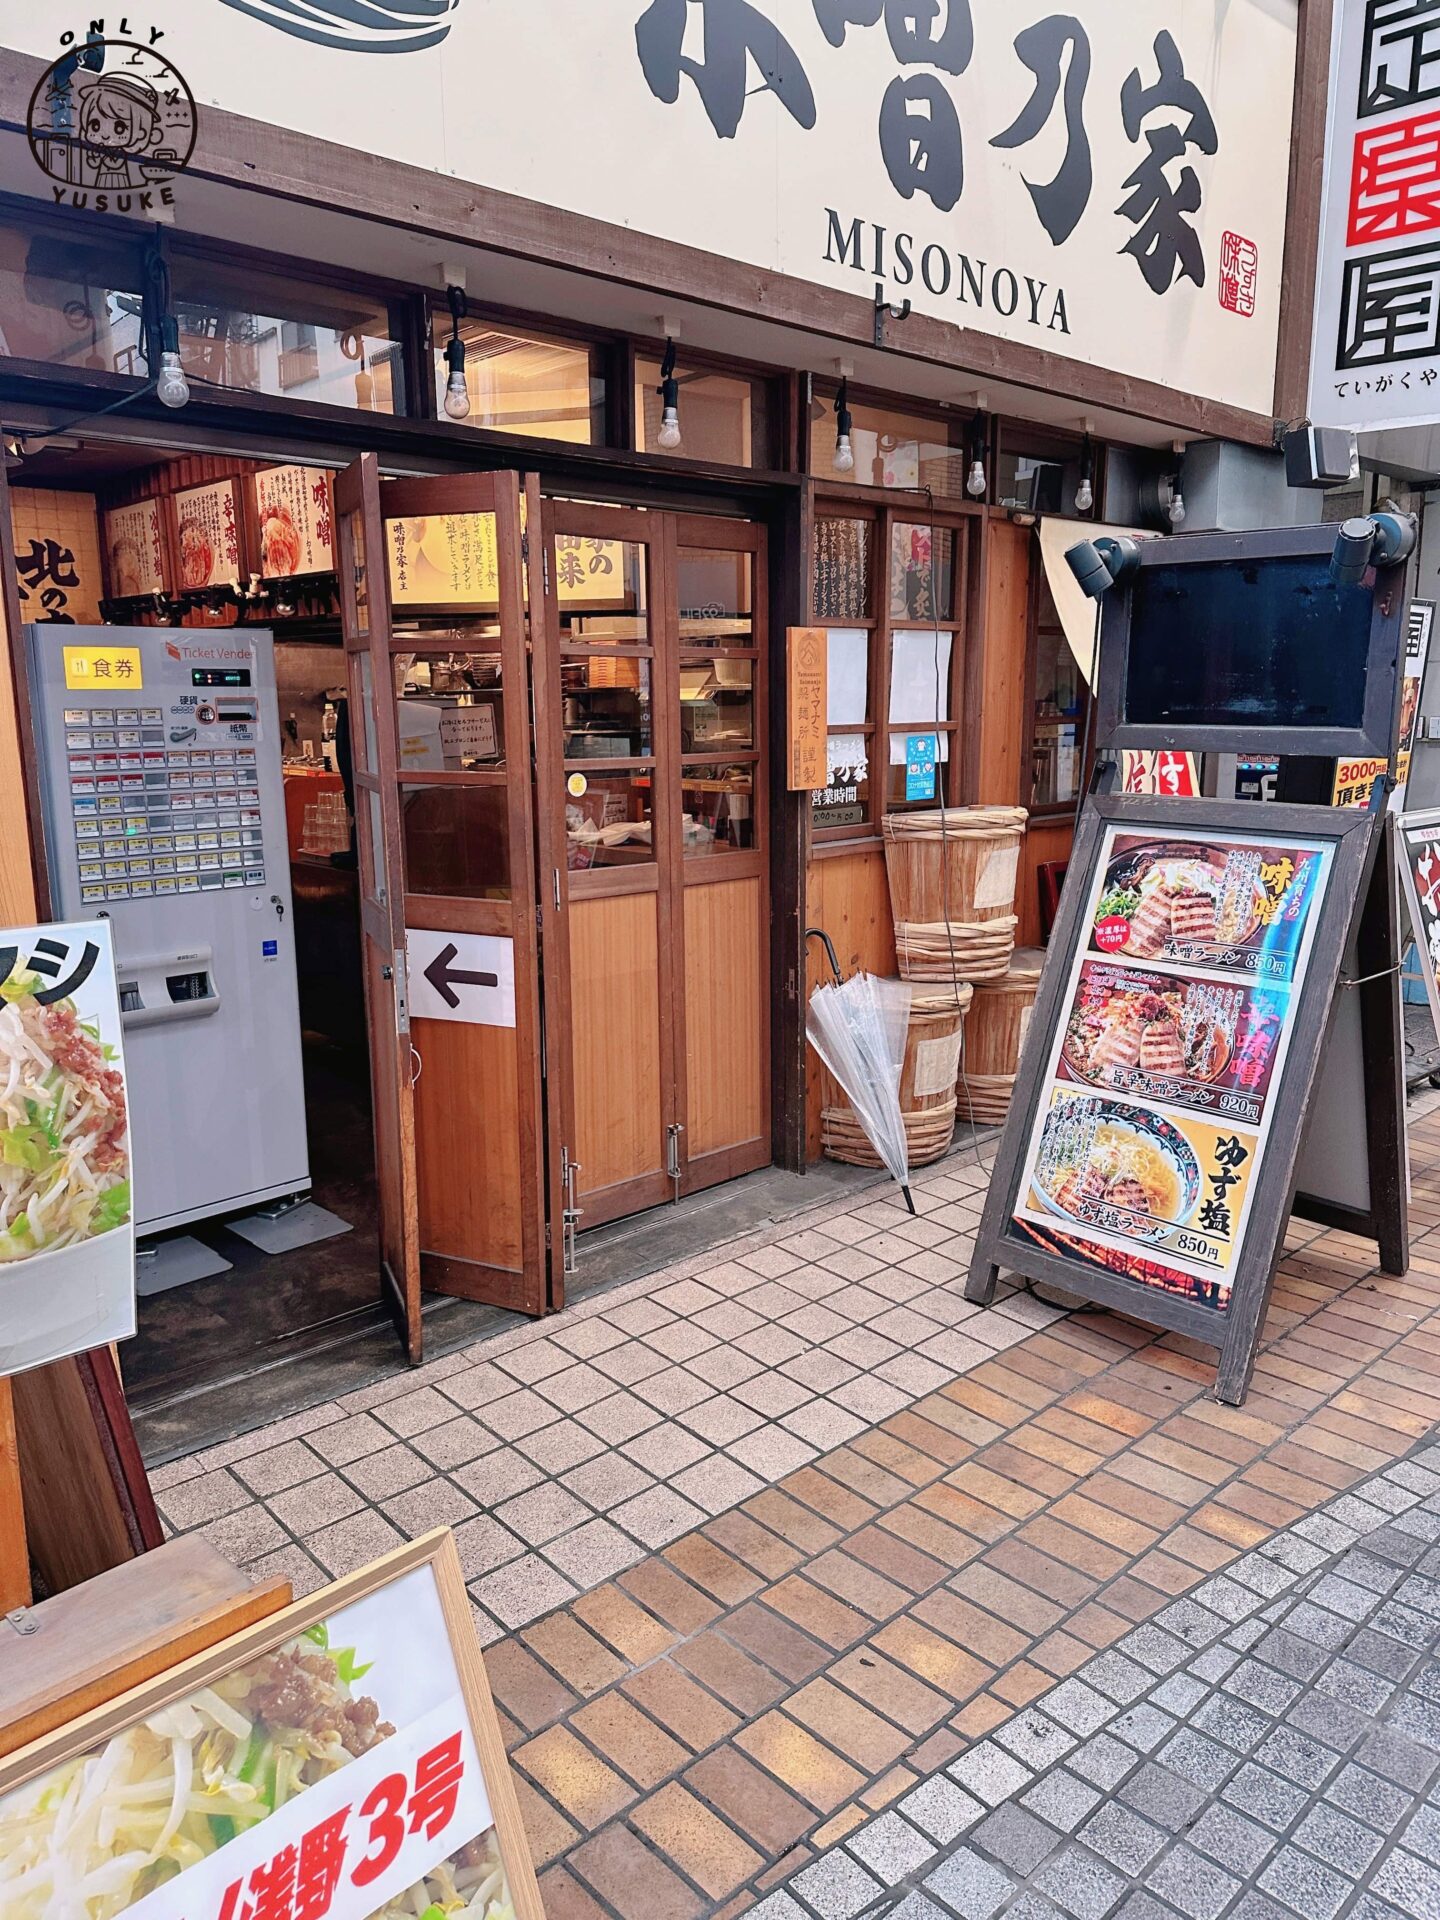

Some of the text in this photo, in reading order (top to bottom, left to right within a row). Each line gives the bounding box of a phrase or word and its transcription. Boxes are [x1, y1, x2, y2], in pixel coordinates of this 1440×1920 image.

[822, 206, 1072, 335] MISONOYA
[1334, 369, 1439, 399] ていがくや
[311, 475, 331, 549] 味噌
[92, 658, 134, 679] 食券
[181, 647, 215, 659] Ticket
[811, 685, 821, 739] ヤマナミ
[812, 786, 857, 807] 営業時間
[1252, 857, 1295, 926] 味噌
[1287, 857, 1312, 917] 九州育ちの
[1164, 941, 1286, 974] 味噌ラーメン 850円
[1230, 995, 1280, 1088] 辛味噌
[1112, 1069, 1259, 1118] 旨辛味噌ラーメン 920円
[1198, 1135, 1249, 1237] ゆず塩
[1079, 1204, 1219, 1261] ゆず塩ラーメン 850円
